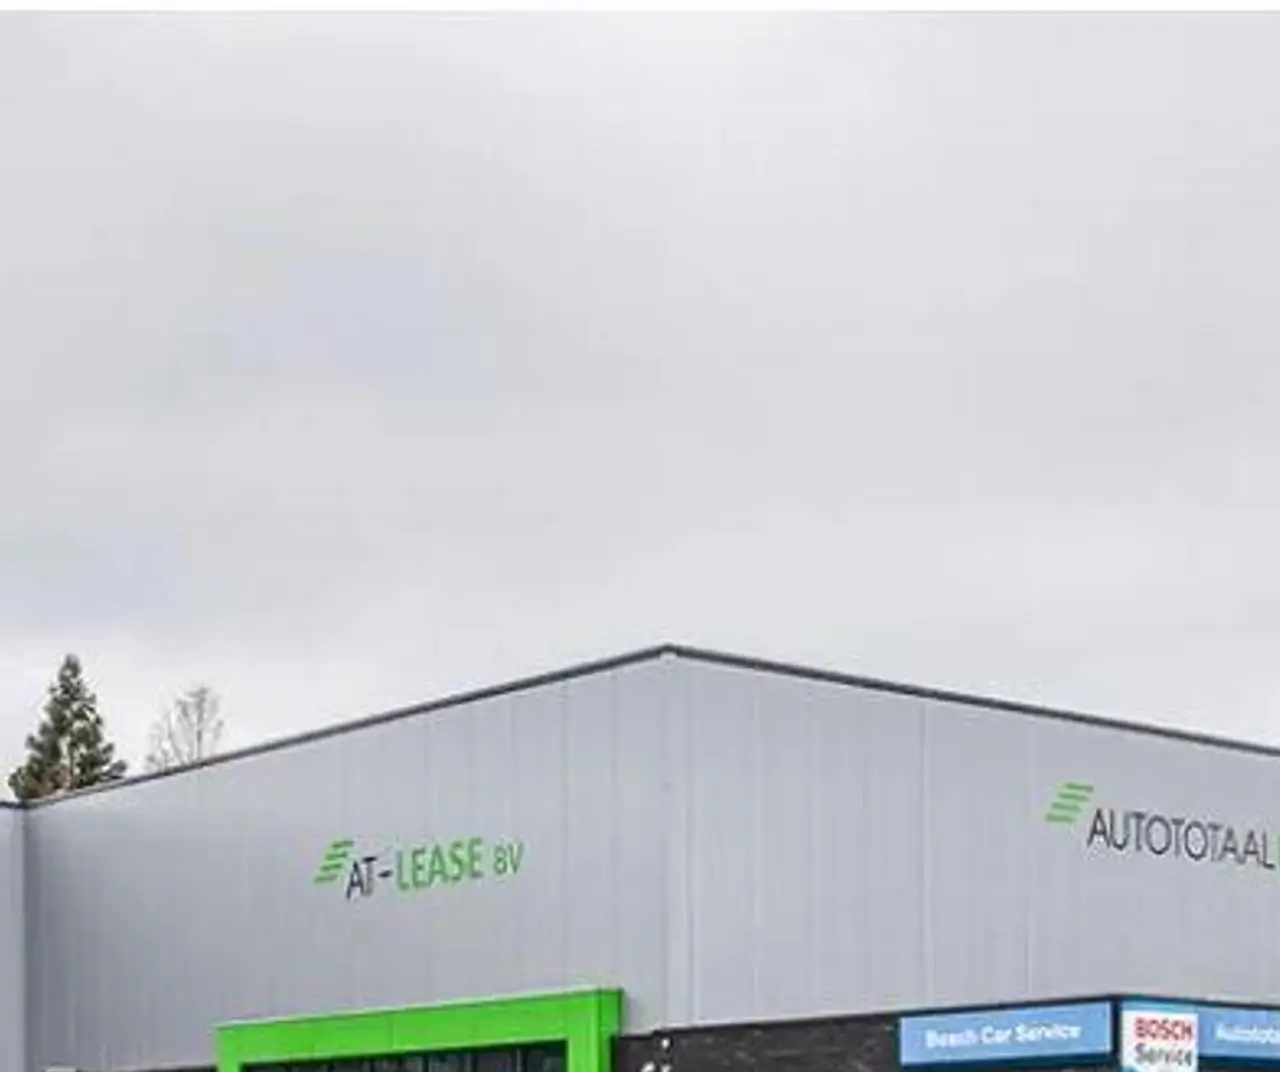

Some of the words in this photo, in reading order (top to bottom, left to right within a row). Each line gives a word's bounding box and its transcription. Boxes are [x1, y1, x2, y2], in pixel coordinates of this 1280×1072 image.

[981, 1025, 1013, 1044] Car
[1014, 1021, 1083, 1043] Service
[1134, 1016, 1193, 1042] BOSCH
[1134, 1042, 1194, 1068] Service
